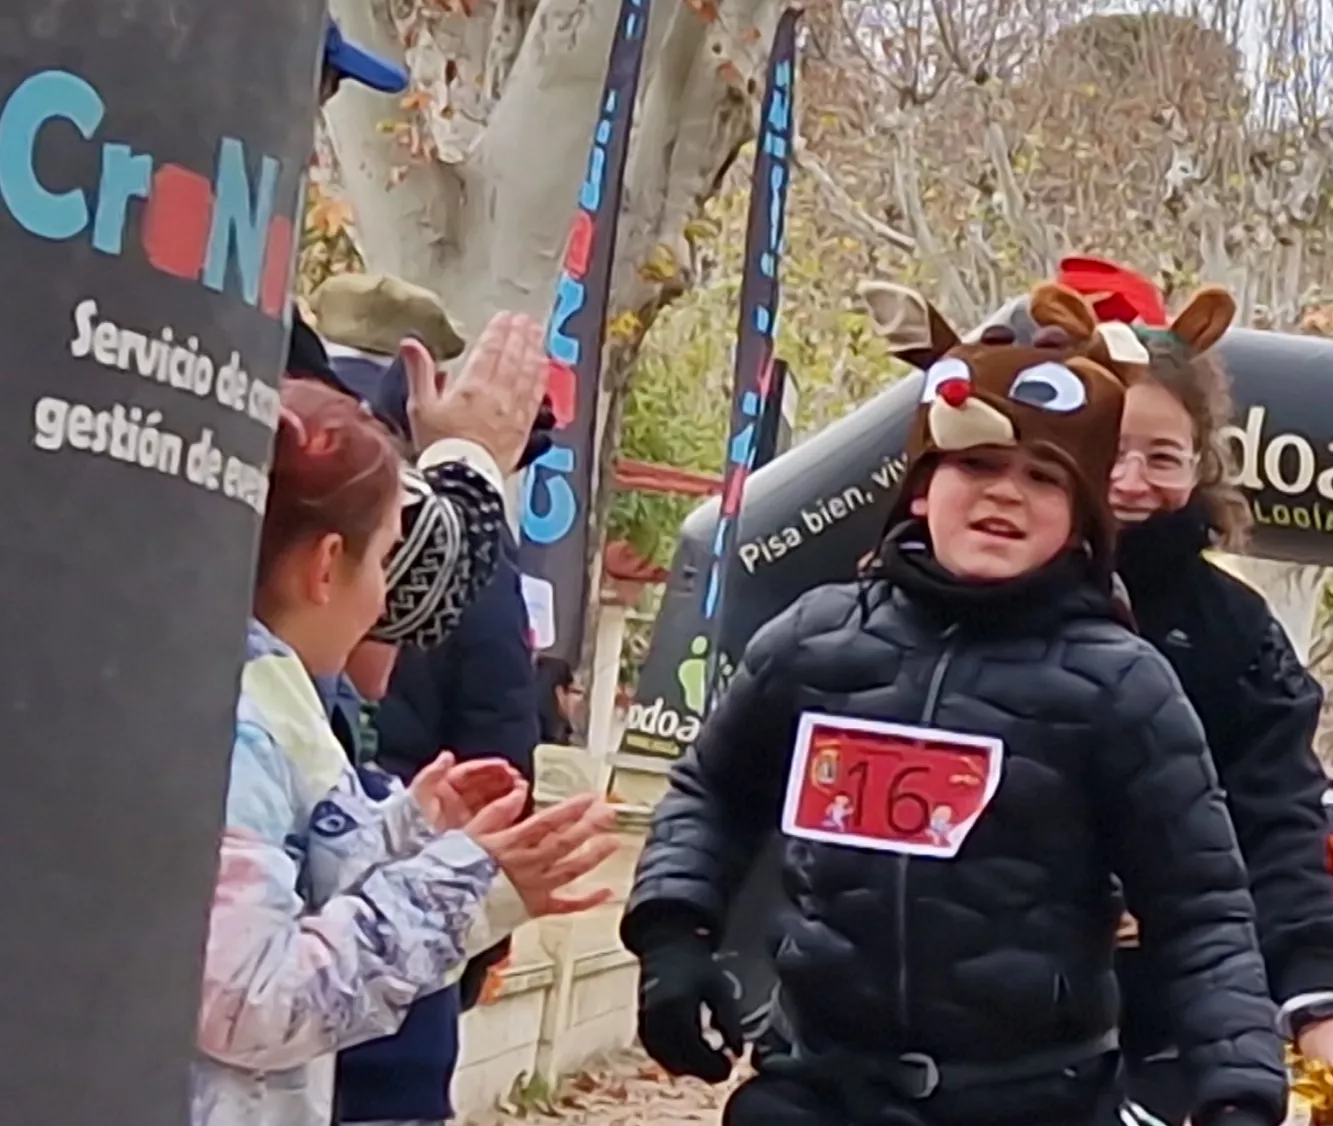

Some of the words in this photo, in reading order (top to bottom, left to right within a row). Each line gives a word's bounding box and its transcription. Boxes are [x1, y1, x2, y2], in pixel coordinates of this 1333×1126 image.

[71, 299, 213, 396] Servicio
[216, 351, 248, 411] de
[34, 397, 183, 475] gestión
[187, 429, 222, 490] de
[738, 527, 804, 574] Pisa
[801, 486, 874, 536] bien,
[847, 761, 931, 836] 16
